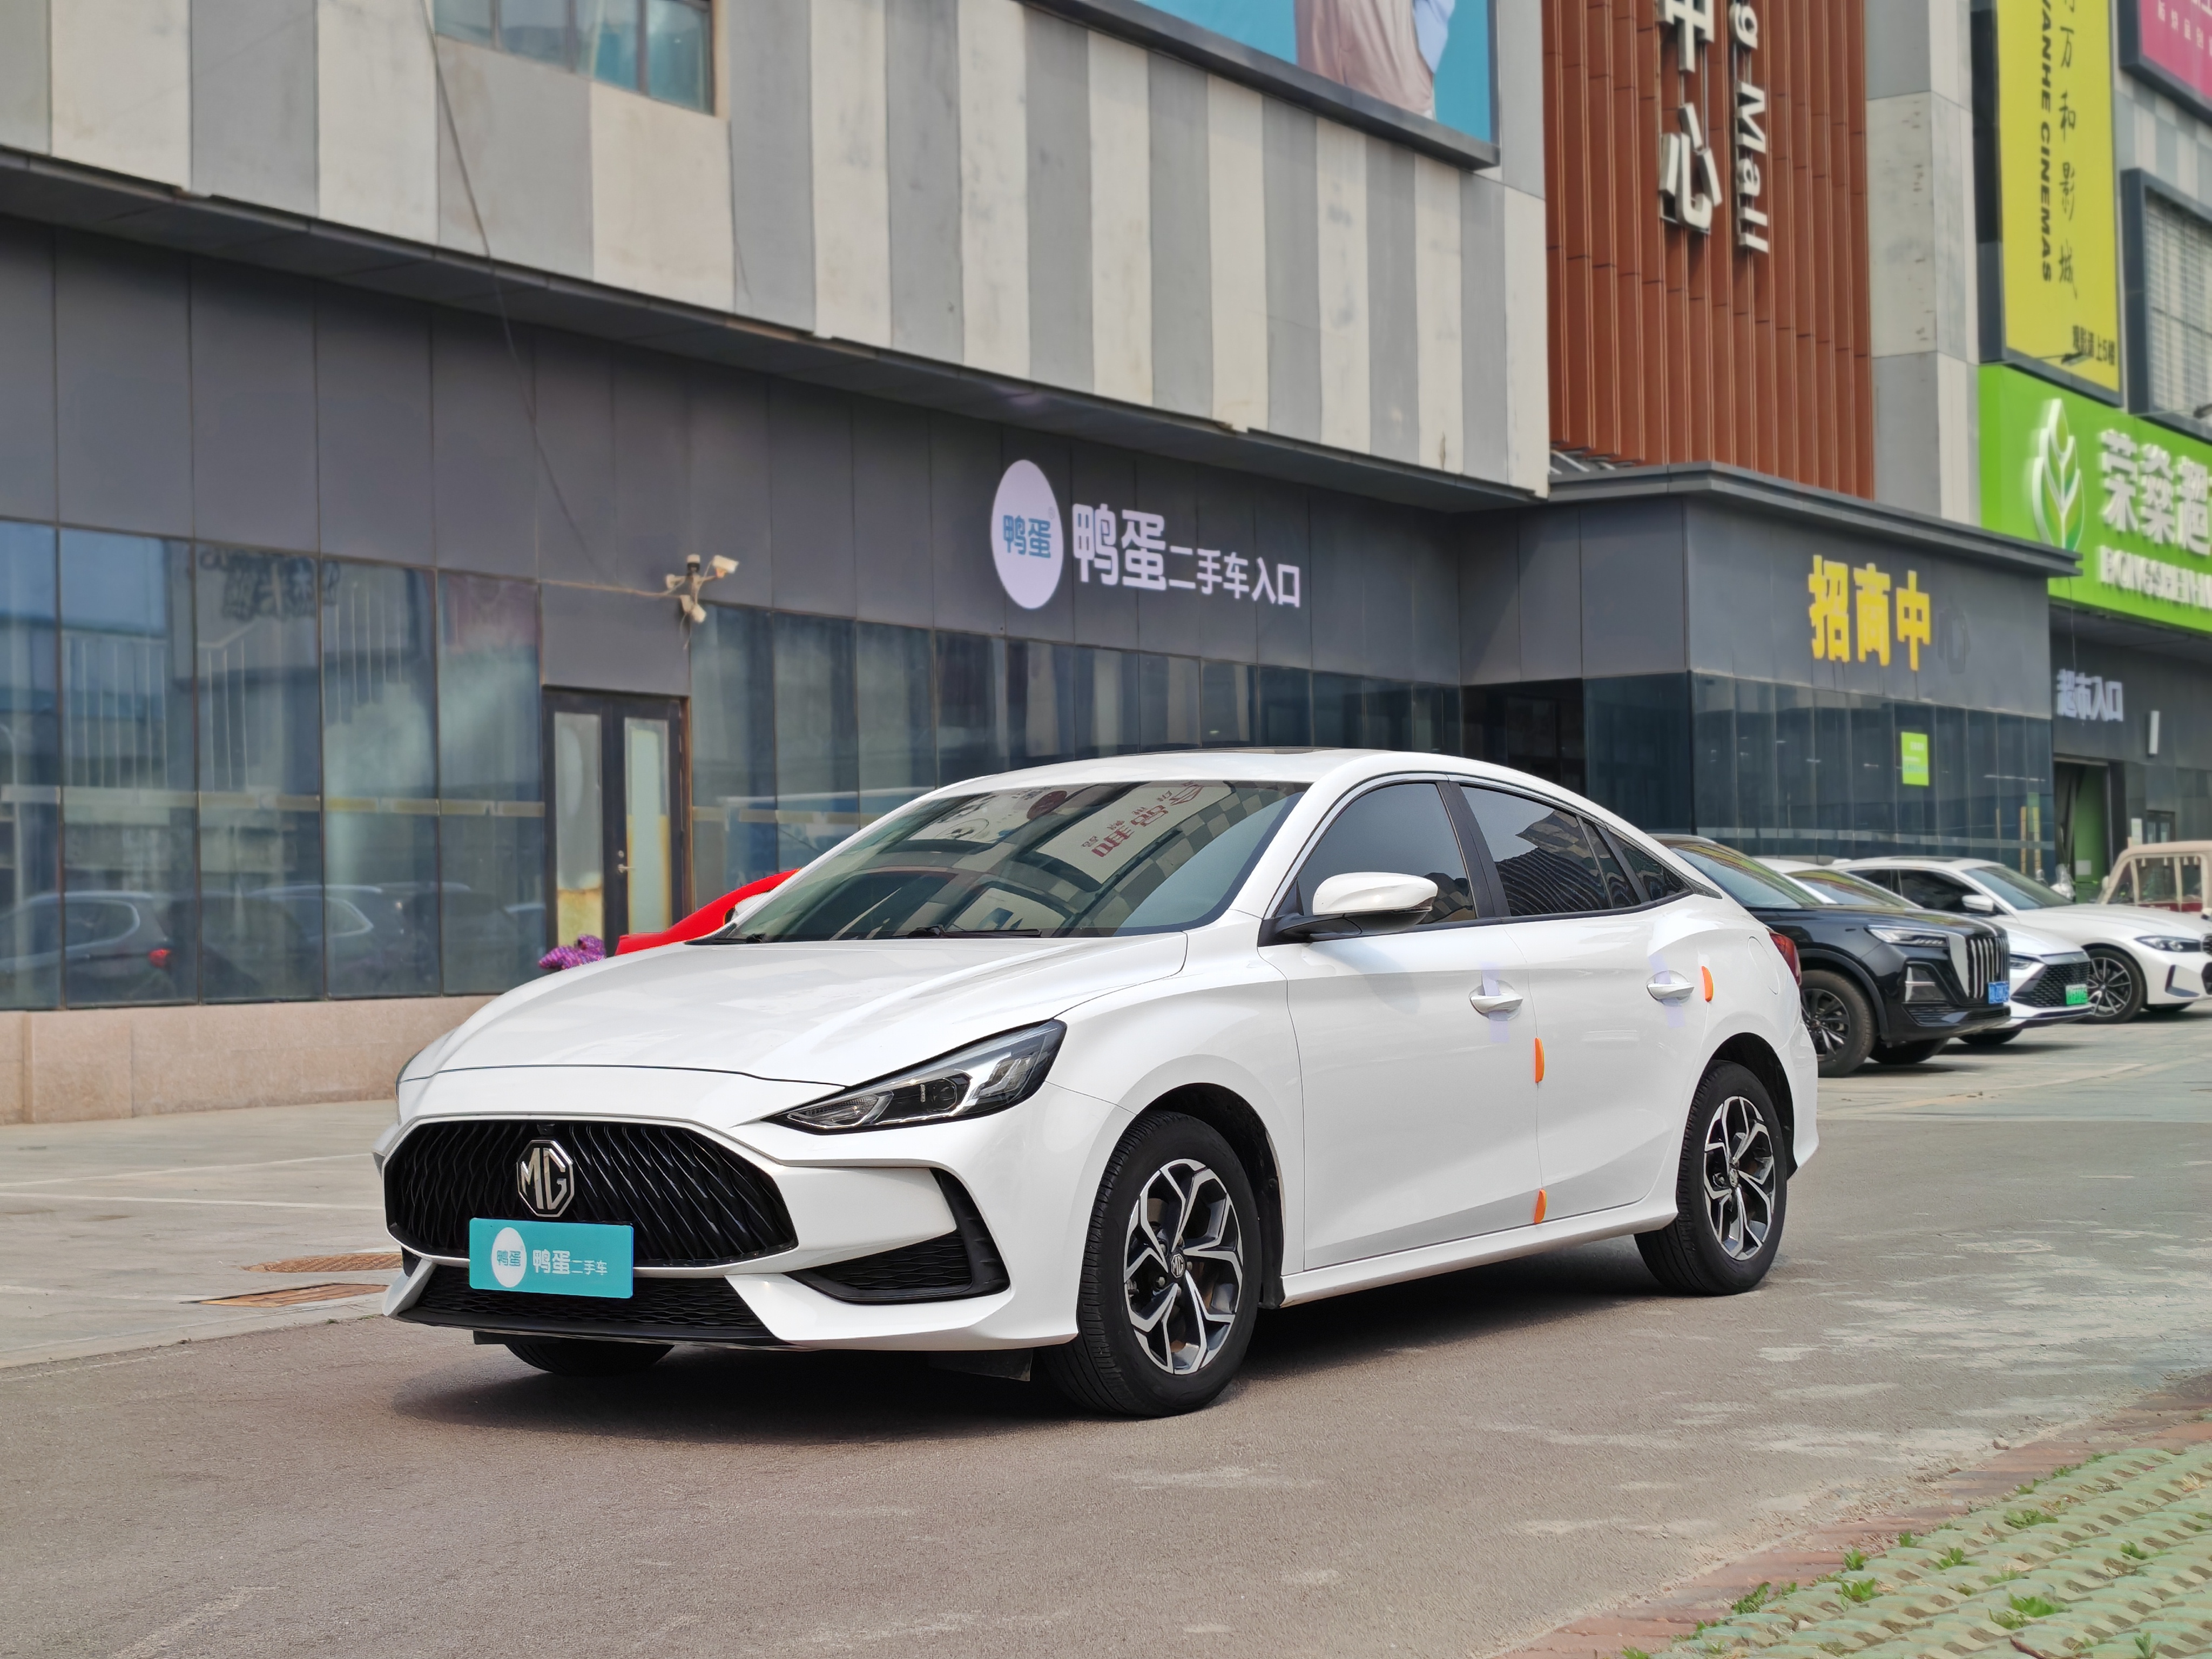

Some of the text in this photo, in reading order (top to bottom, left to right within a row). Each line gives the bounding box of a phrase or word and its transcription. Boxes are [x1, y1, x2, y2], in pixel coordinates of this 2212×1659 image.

[1734, 80, 1770, 254] Mall
[2041, 122, 2052, 282] CINEMAS
[1003, 515, 1051, 559] 鸭蛋
[1072, 503, 1300, 608] 鸭蛋二手车入口
[1808, 554, 1931, 671] 招商中
[2056, 668, 2123, 722] 超市入口
[520, 1147, 567, 1210] MG
[532, 1249, 608, 1276] 鸭蛋二手车
[1172, 1256, 1184, 1276] MG
